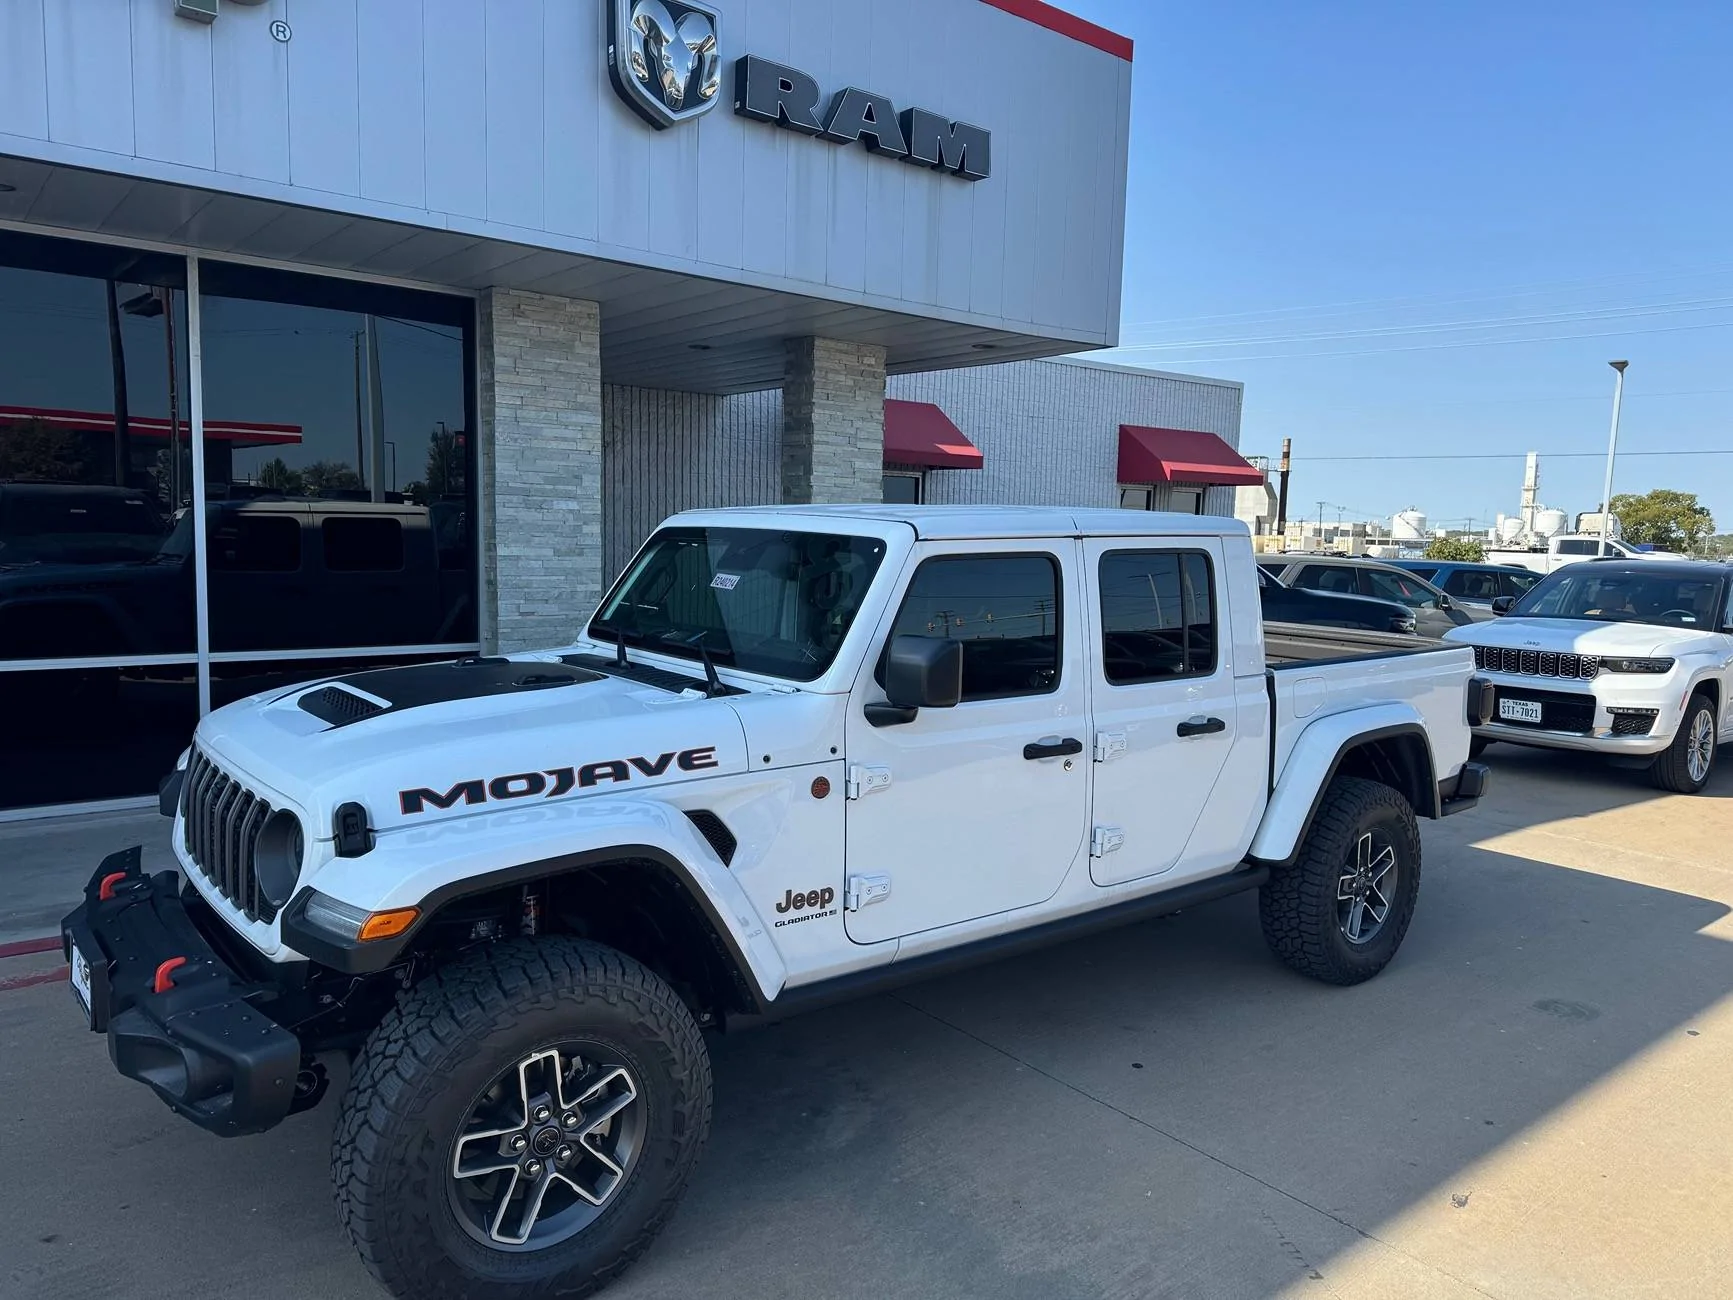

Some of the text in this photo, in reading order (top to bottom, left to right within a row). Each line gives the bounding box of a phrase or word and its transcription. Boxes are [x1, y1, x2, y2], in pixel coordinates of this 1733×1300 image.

[735, 54, 991, 181] RAM
[399, 746, 719, 815] MOJAVE
[775, 886, 835, 914] Jeep
[775, 911, 828, 927] GLADIATOR
